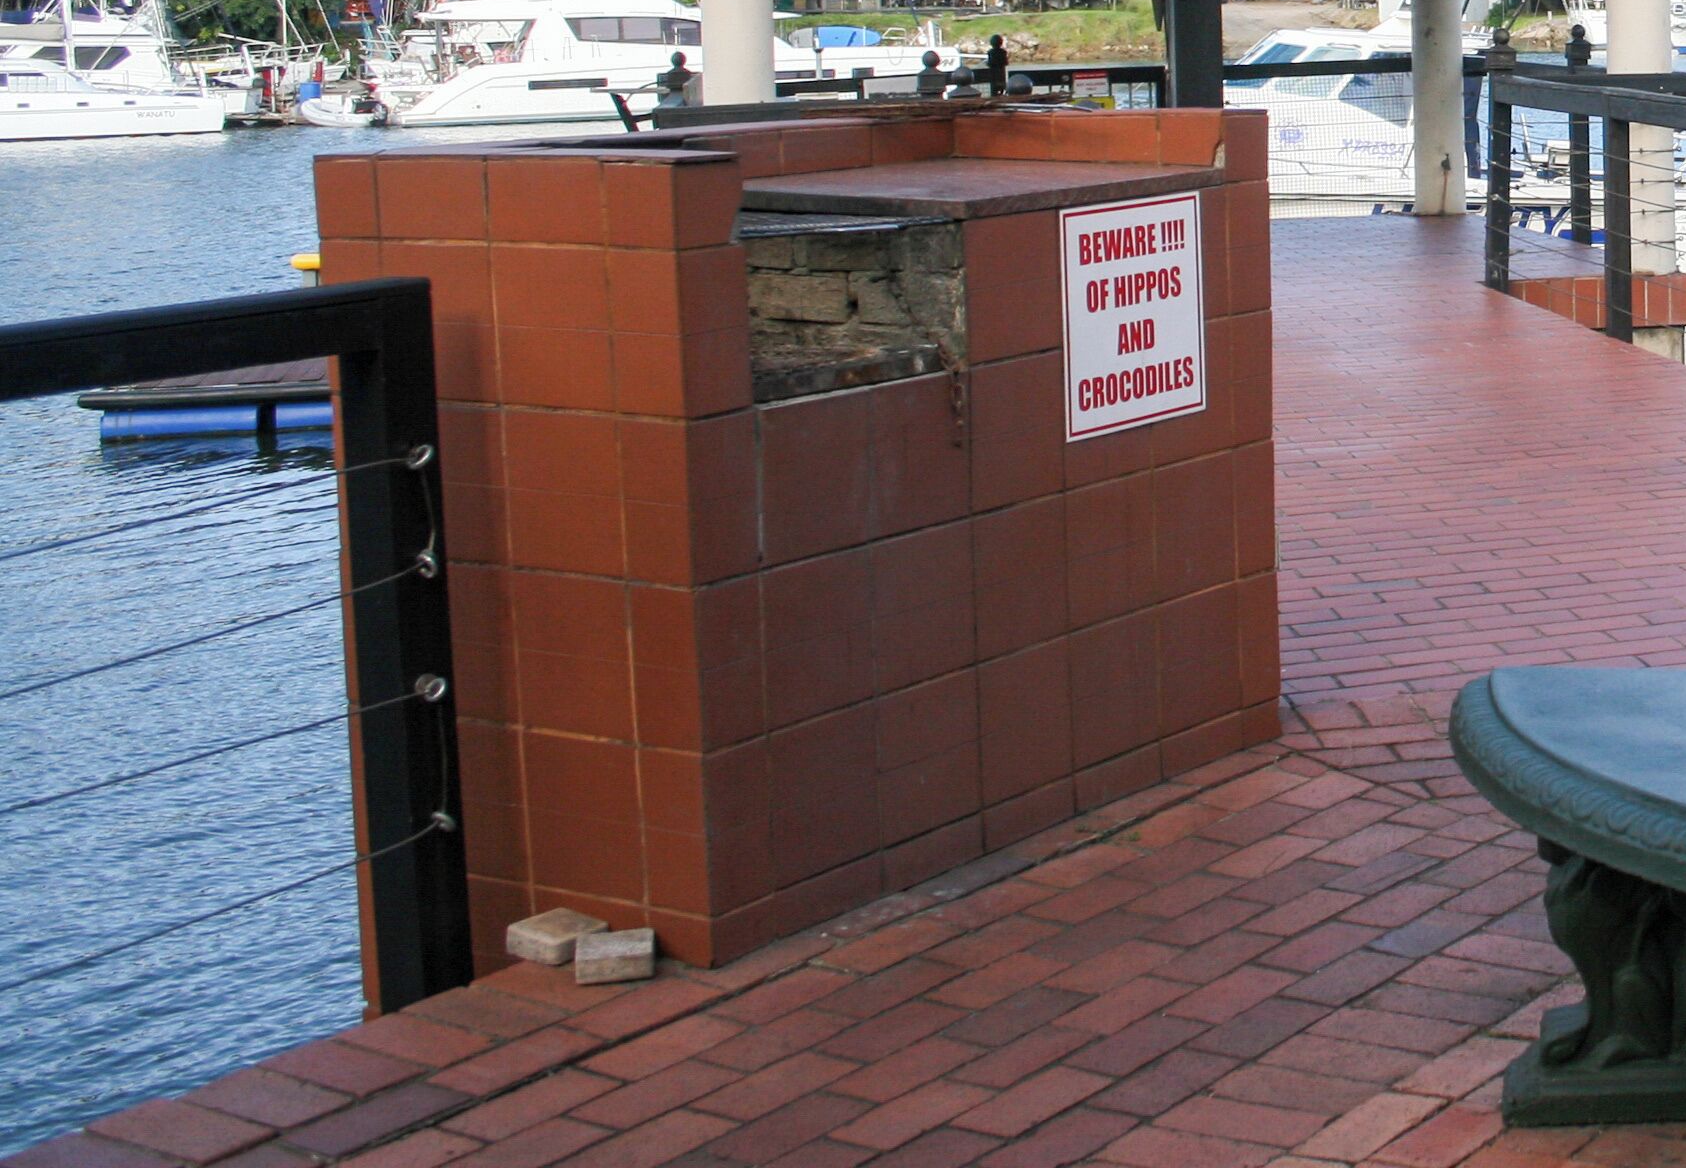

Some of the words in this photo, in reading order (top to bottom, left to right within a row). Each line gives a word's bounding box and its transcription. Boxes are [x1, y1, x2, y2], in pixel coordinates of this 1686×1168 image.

[1078, 224, 1156, 265] BEWARE
[1086, 278, 1109, 313] OF
[1114, 266, 1181, 307] HIPPOS
[1117, 319, 1155, 355] AND
[1078, 356, 1193, 411] CROCODILES
